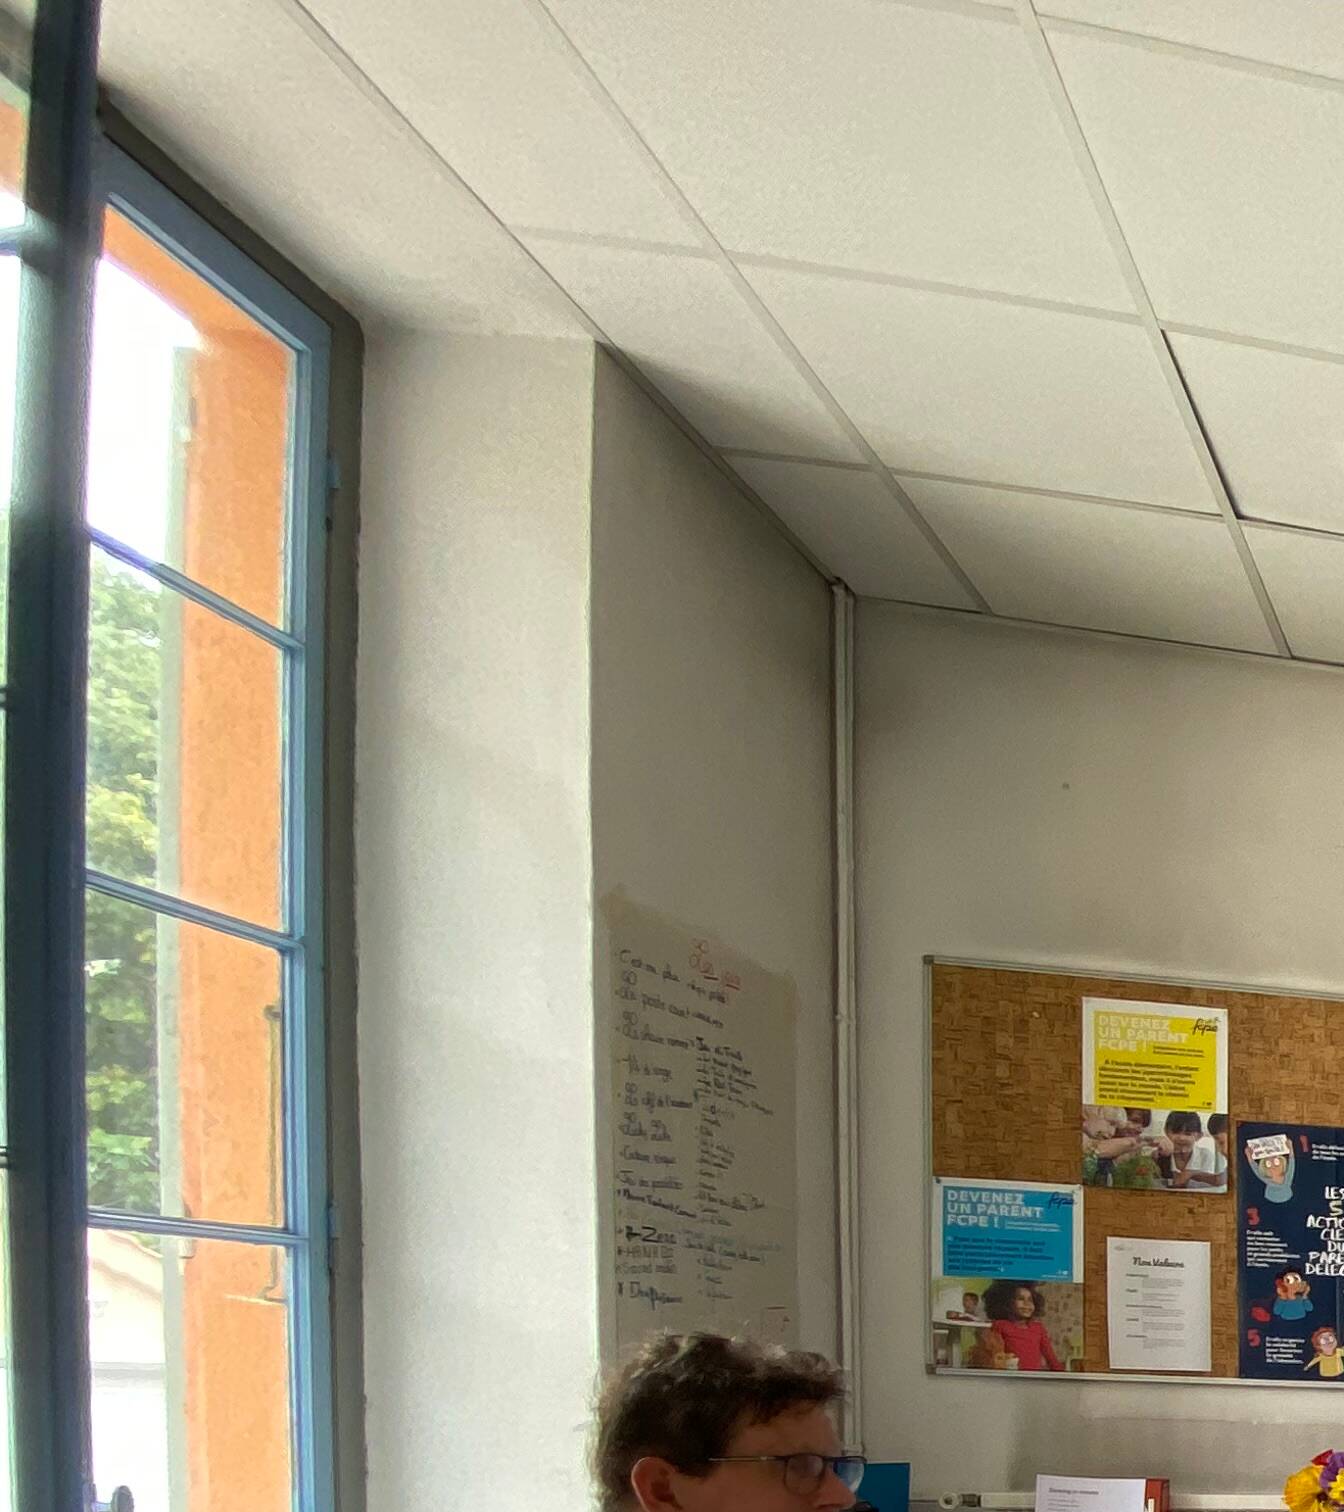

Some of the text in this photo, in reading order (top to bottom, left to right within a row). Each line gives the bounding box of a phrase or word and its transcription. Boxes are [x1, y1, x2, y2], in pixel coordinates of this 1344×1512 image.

[1099, 1016, 1169, 1028] DEVENEZ
[1099, 1027, 1188, 1043] UN PARENT
[1099, 1040, 1137, 1051] FCPE
[1300, 1135, 1309, 1152] 1
[948, 1190, 1024, 1204] DEVENEZ
[948, 1203, 1044, 1218] UN PARENT
[1247, 1207, 1260, 1225] 3
[947, 1215, 989, 1227] FCPE
[1247, 1328, 1261, 1346] 5
